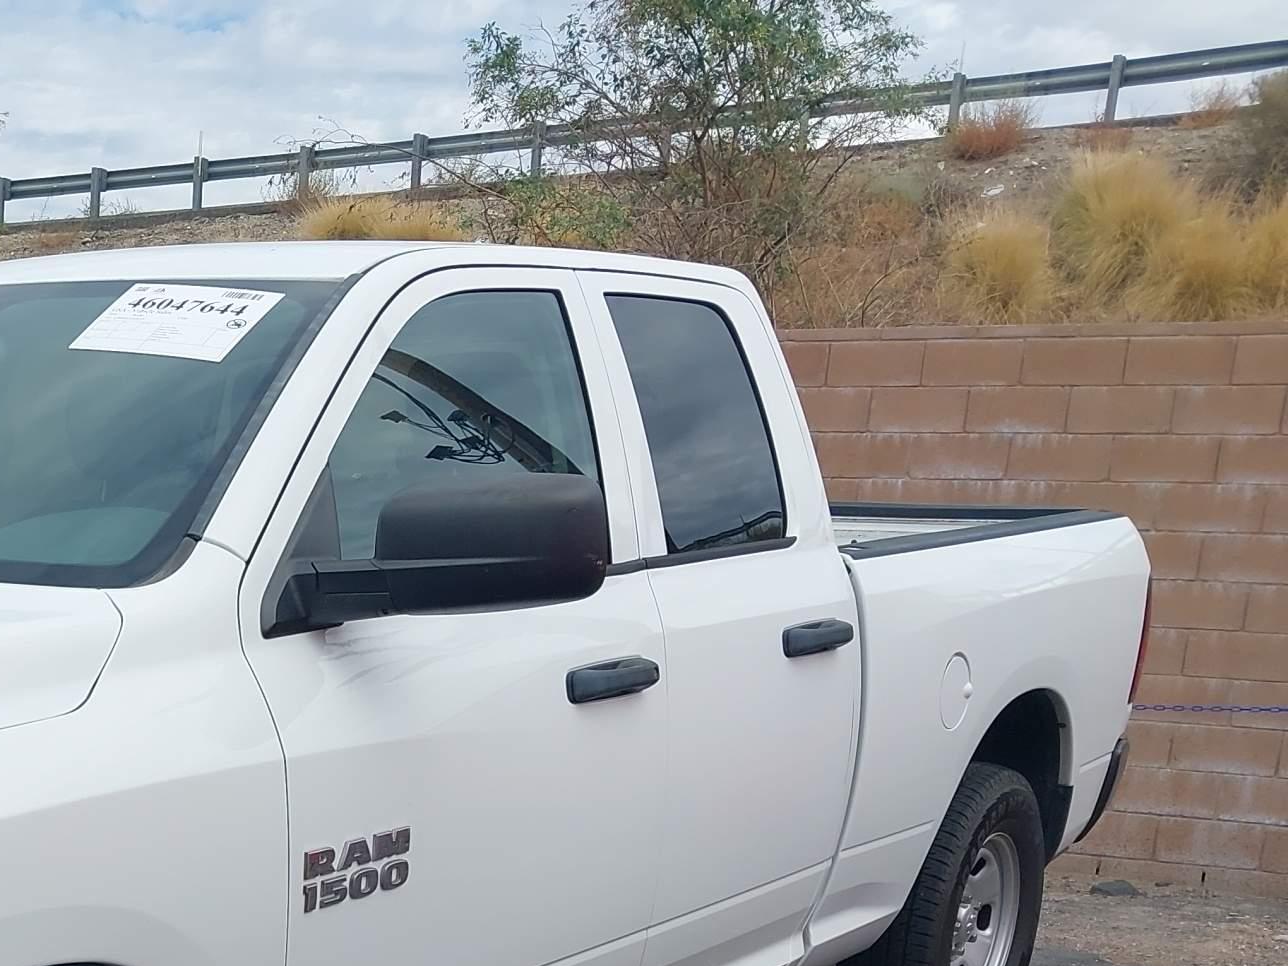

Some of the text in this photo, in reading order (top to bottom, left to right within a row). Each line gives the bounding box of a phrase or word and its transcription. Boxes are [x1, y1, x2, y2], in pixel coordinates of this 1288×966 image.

[128, 297, 249, 316] 46047644
[303, 826, 411, 881] RAM
[302, 859, 410, 914] 1500
